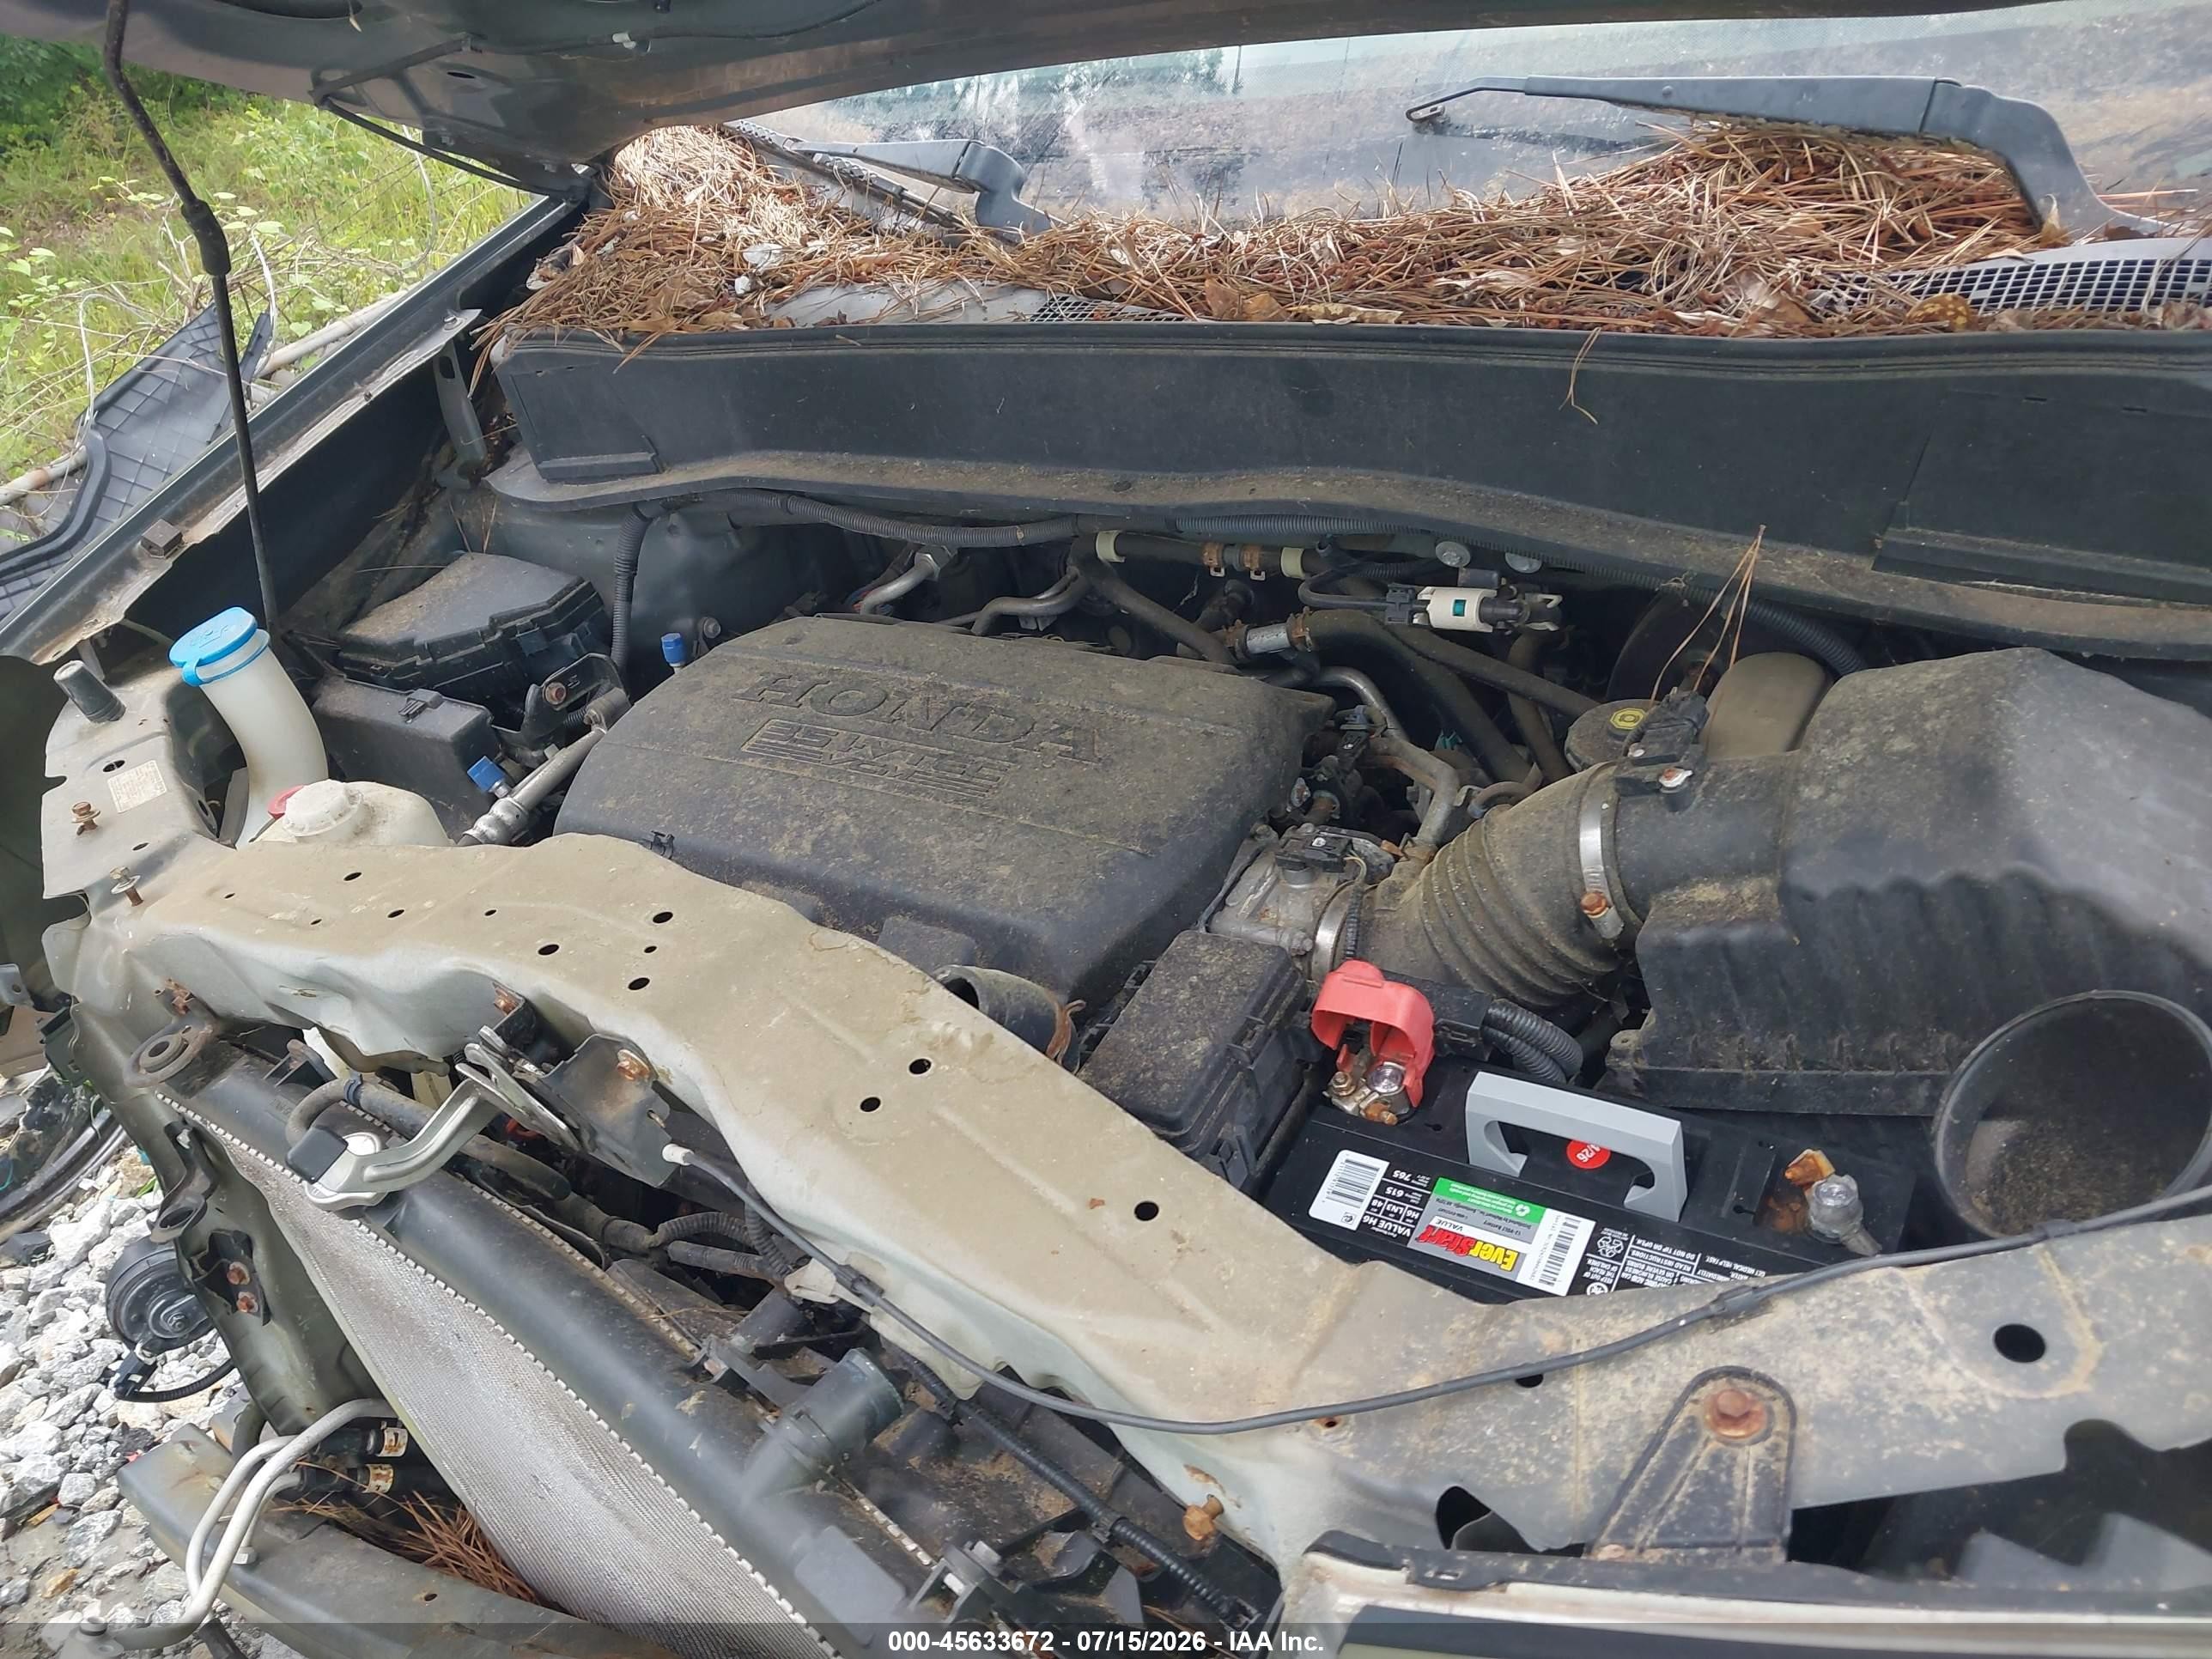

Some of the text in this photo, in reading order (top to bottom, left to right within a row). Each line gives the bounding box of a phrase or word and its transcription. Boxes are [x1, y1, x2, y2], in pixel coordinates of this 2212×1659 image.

[732, 672, 1103, 765] HONDA
[1393, 1170, 1412, 1182] 765
[1385, 1187, 1405, 1197] 615
[1371, 1199, 1383, 1207] 48
[1386, 1204, 1404, 1214] LN3
[1406, 1211, 1420, 1219] H6
[1362, 1215, 1411, 1237] VALUE H6
[1435, 1219, 1463, 1231] VALUE
[1416, 1224, 1519, 1272] EverStart
[1674, 1249, 1686, 1257] NOT
[1686, 1252, 1695, 1261] DO
[1589, 1267, 1606, 1276] REACH
[1645, 1266, 1666, 1274] SEVERE
[1674, 1262, 1692, 1272] READ
[1705, 1255, 1765, 1278] GET MEDICAL HELP FAST.
[1601, 1276, 1613, 1285] KEEP
[1621, 1272, 1632, 1280] CAN
[1625, 1266, 1673, 1285] CAUSE BLINDNESS
[1632, 1275, 1645, 1285] ACID
